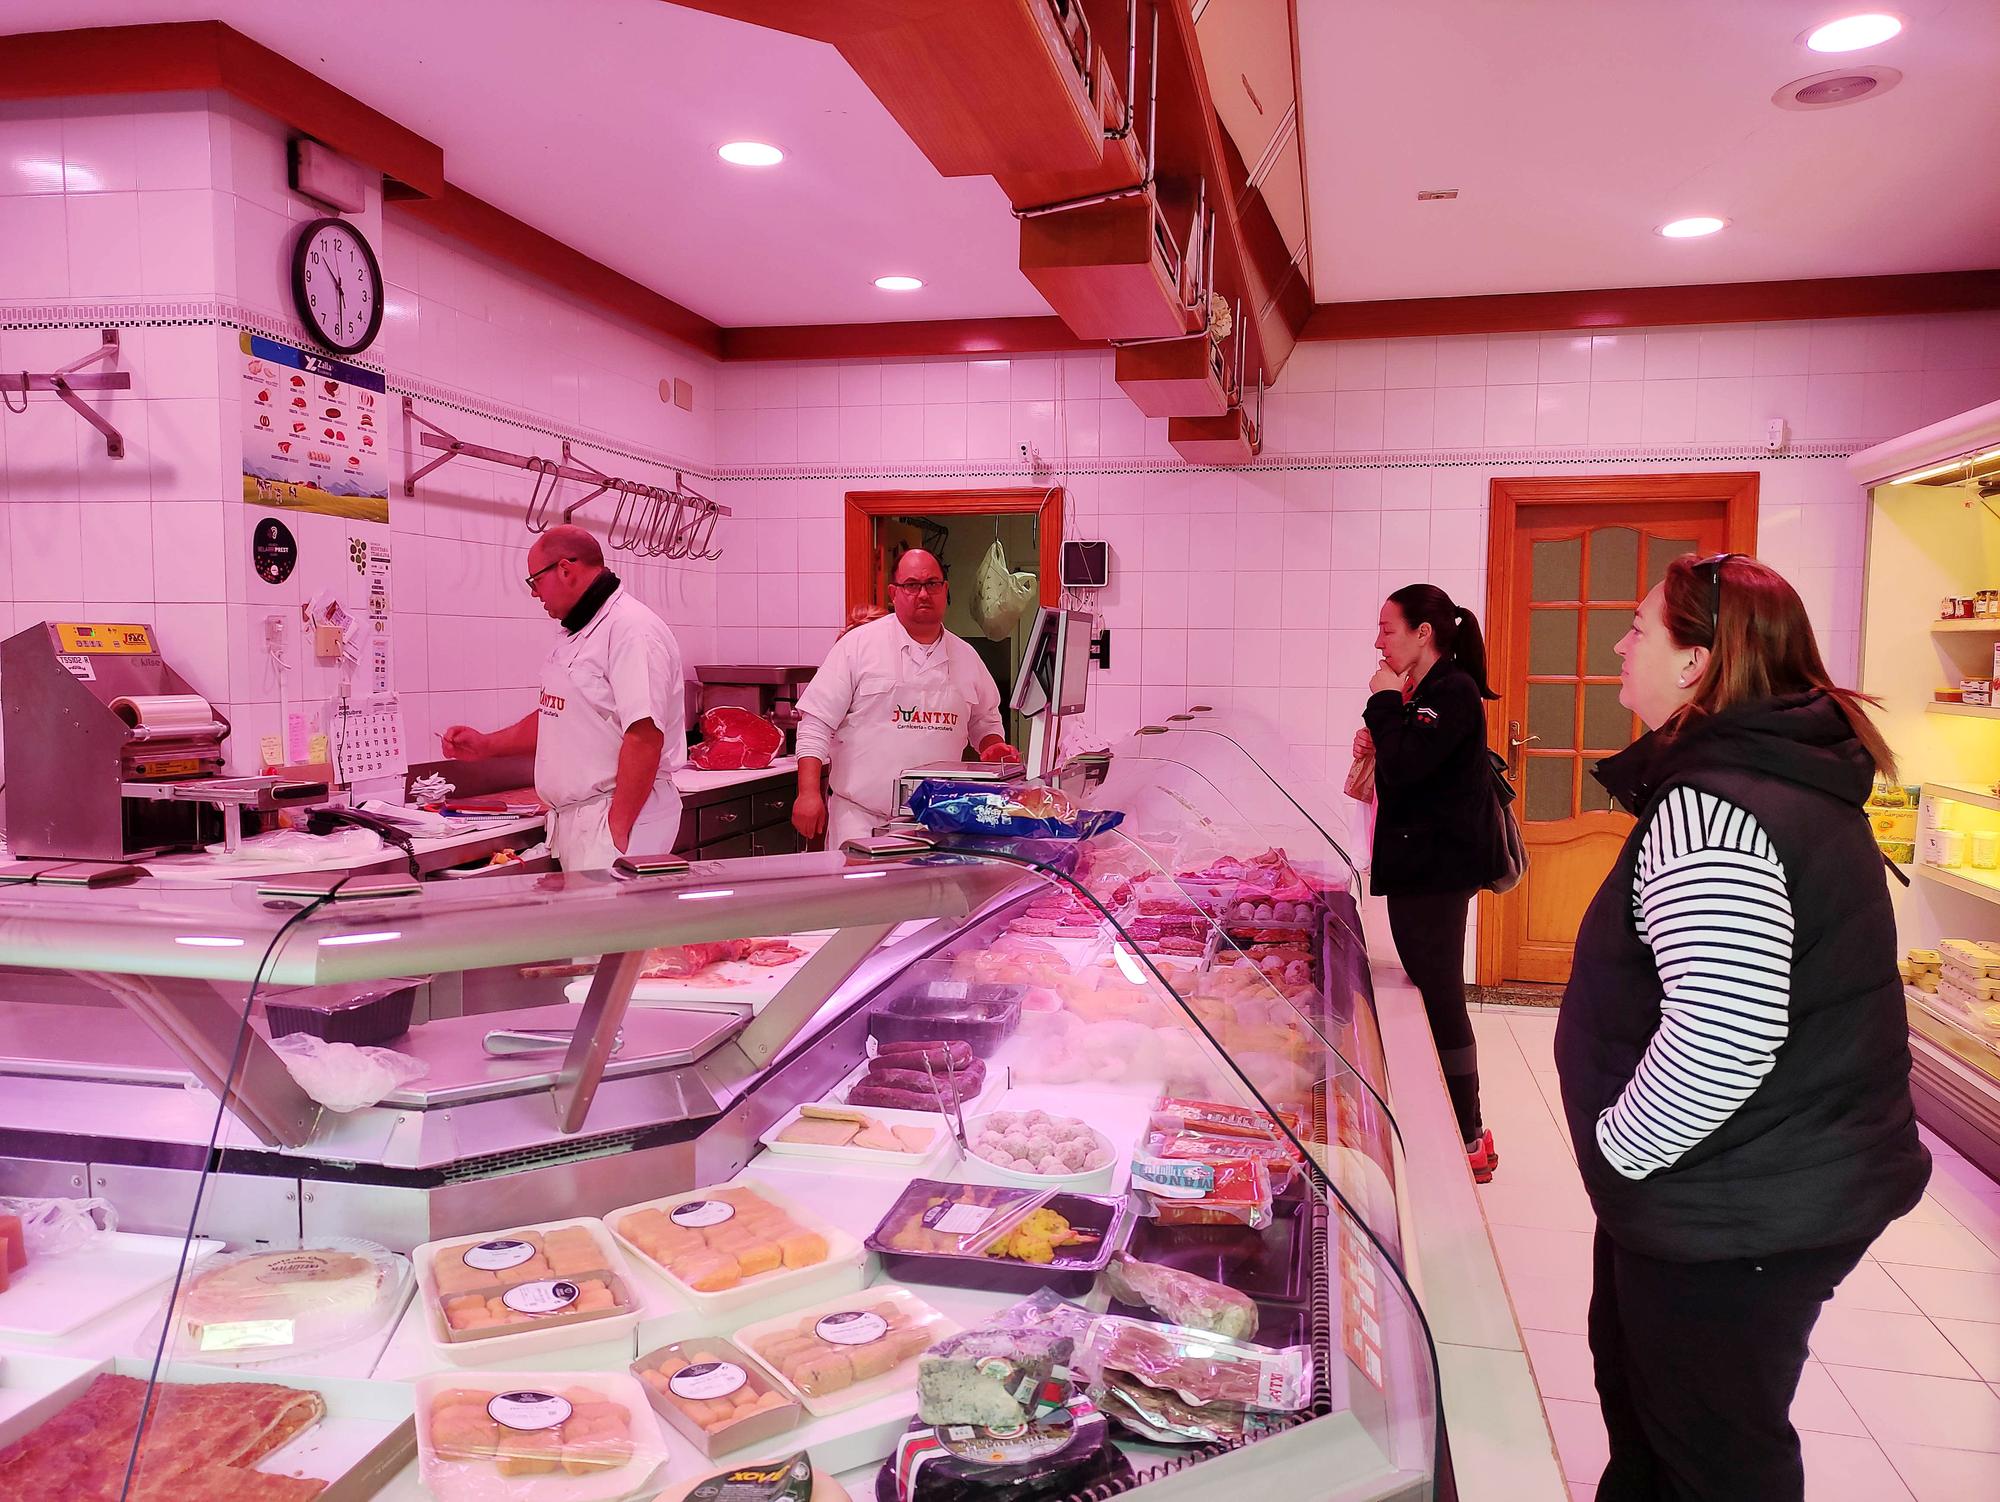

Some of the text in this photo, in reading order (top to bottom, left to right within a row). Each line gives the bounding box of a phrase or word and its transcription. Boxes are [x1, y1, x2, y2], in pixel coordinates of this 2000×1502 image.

[321, 239, 328, 253] 11
[334, 239, 342, 252] 12
[311, 252, 319, 264] 10
[350, 251, 353, 262] 1
[306, 270, 311, 282] 9
[358, 269, 363, 281] 2
[311, 294, 316, 307] 8
[362, 290, 367, 302] 3
[321, 312, 326, 324] 7
[358, 311, 362, 322] 4
[335, 323, 340, 335] 6
[349, 322, 353, 333] 5
[892, 706, 958, 725] JUANTXU
